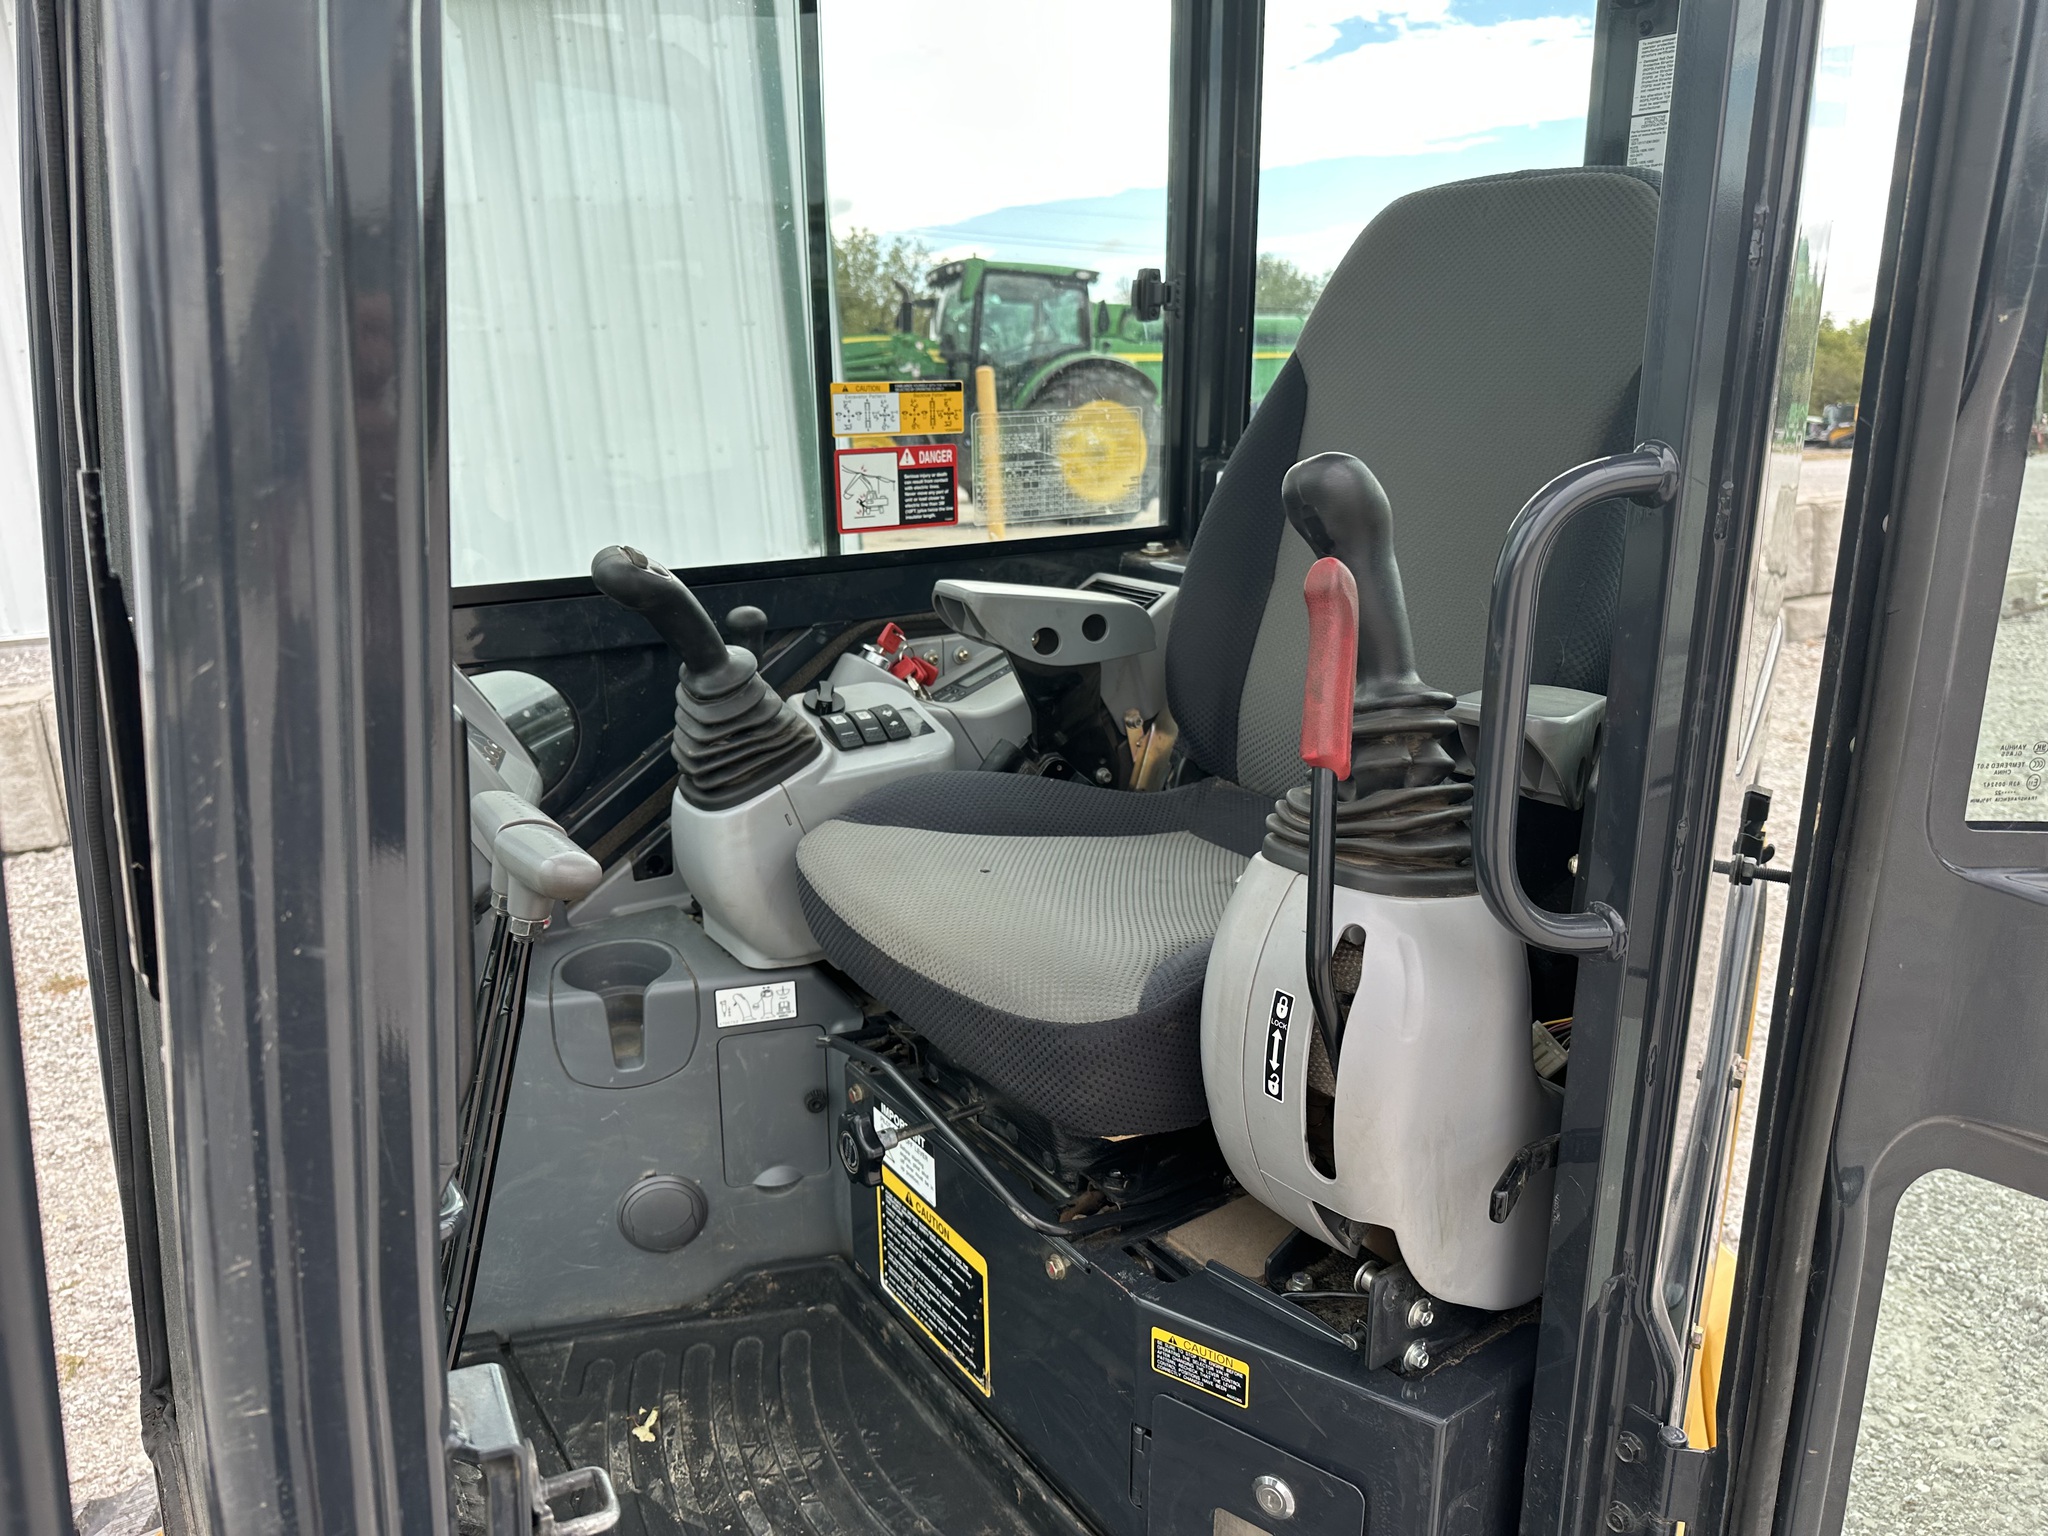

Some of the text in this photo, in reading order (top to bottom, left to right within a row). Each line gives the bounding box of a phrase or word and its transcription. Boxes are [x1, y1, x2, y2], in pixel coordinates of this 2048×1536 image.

[919, 450, 952, 464] DANGER
[1271, 1018, 1287, 1030] LOCK
[915, 1202, 950, 1241] CAUTION
[1183, 1340, 1233, 1368] CAUTION
